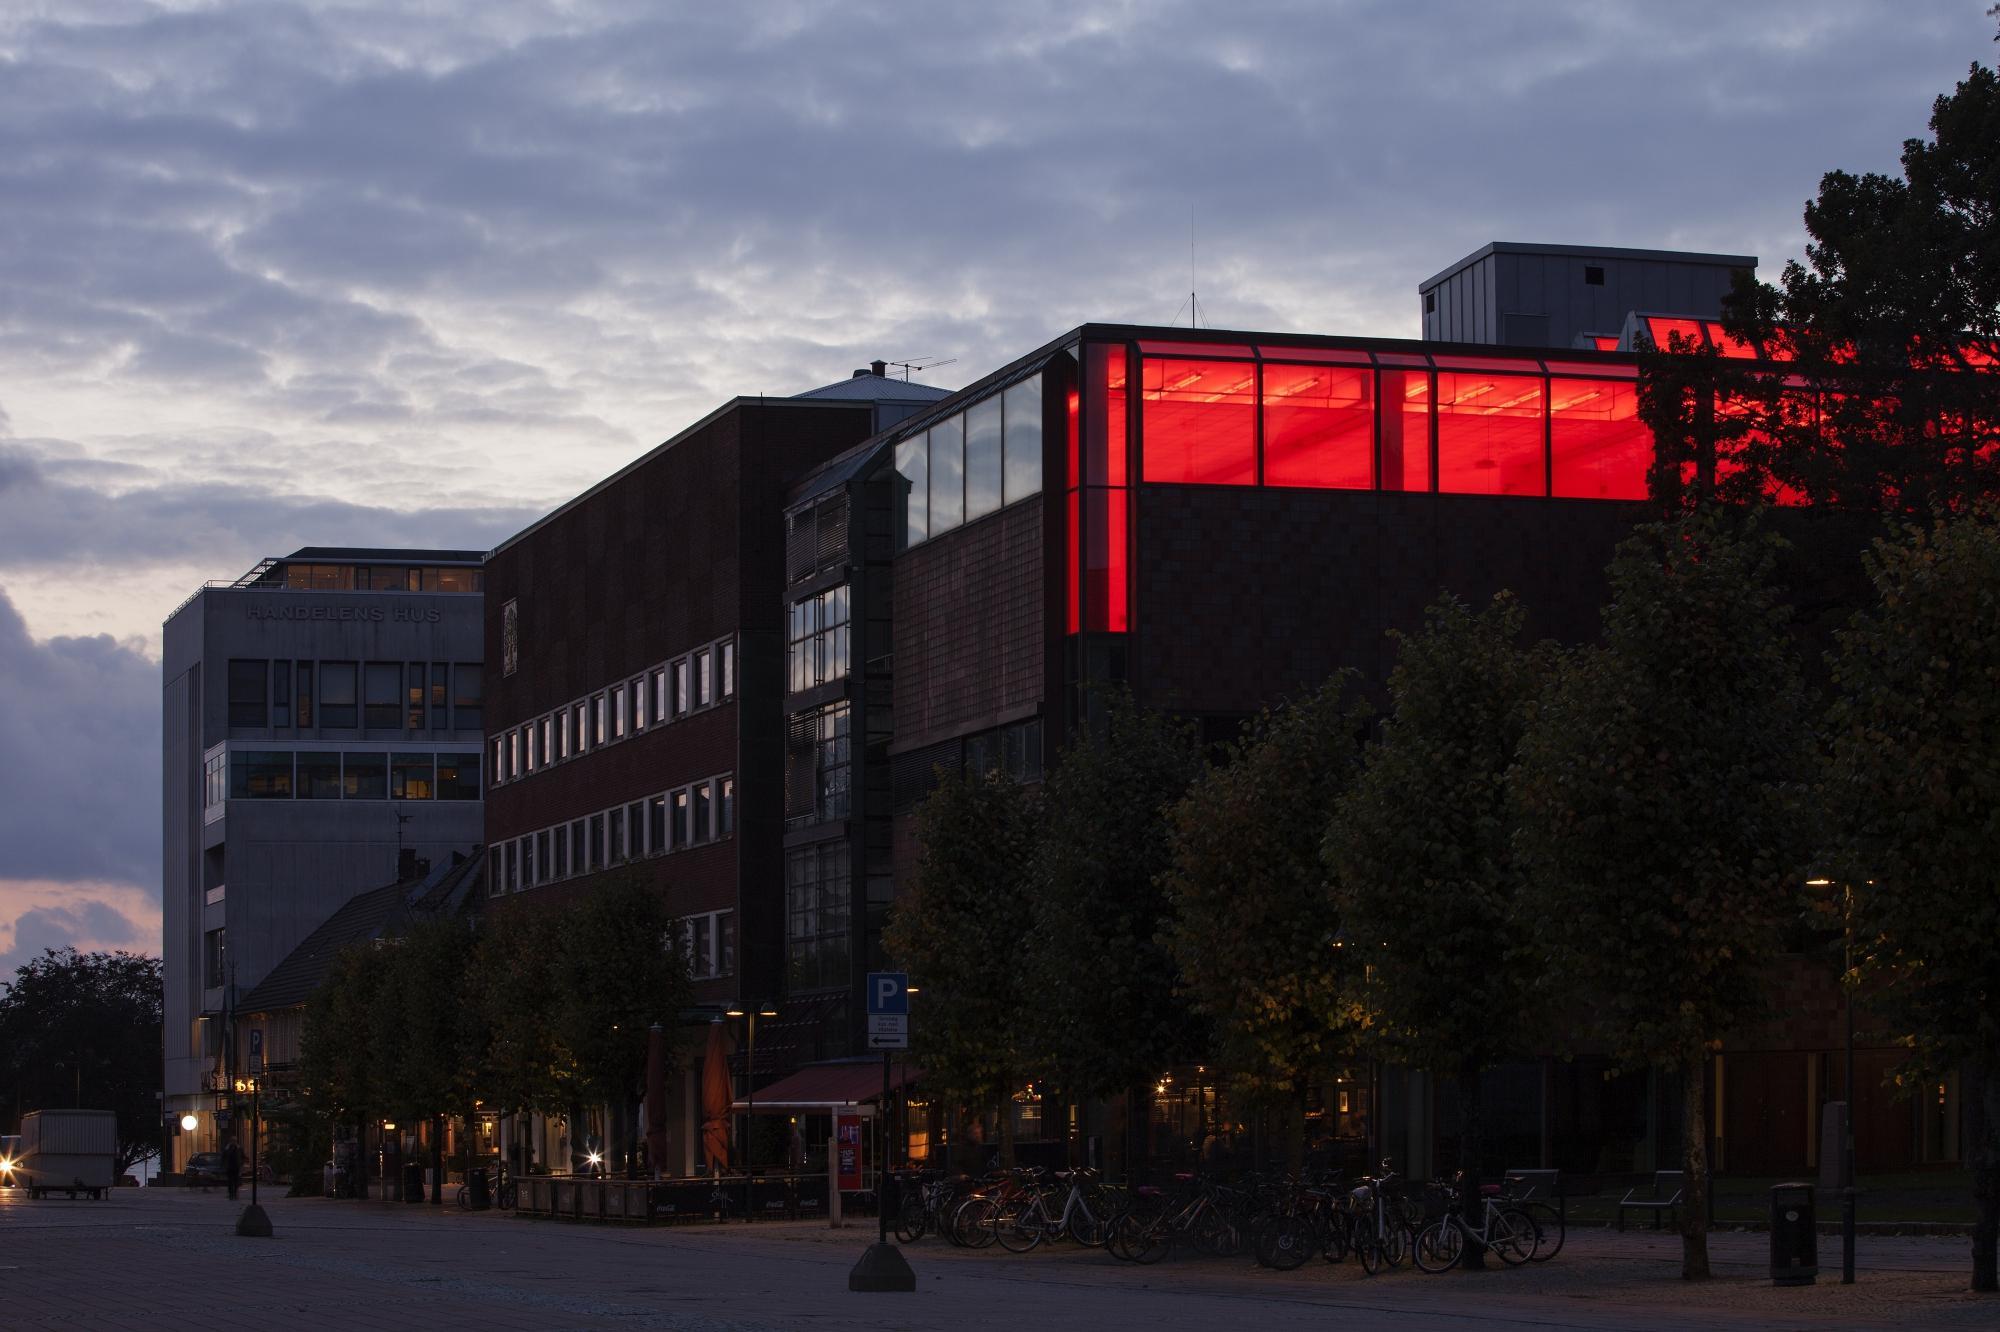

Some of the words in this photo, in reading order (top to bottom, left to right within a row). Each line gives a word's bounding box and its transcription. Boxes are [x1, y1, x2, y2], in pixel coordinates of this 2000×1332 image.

[247, 606, 385, 621] HANDELENS
[394, 608, 441, 623] HUS
[878, 978, 898, 1009] P
[252, 1031, 261, 1052] P
